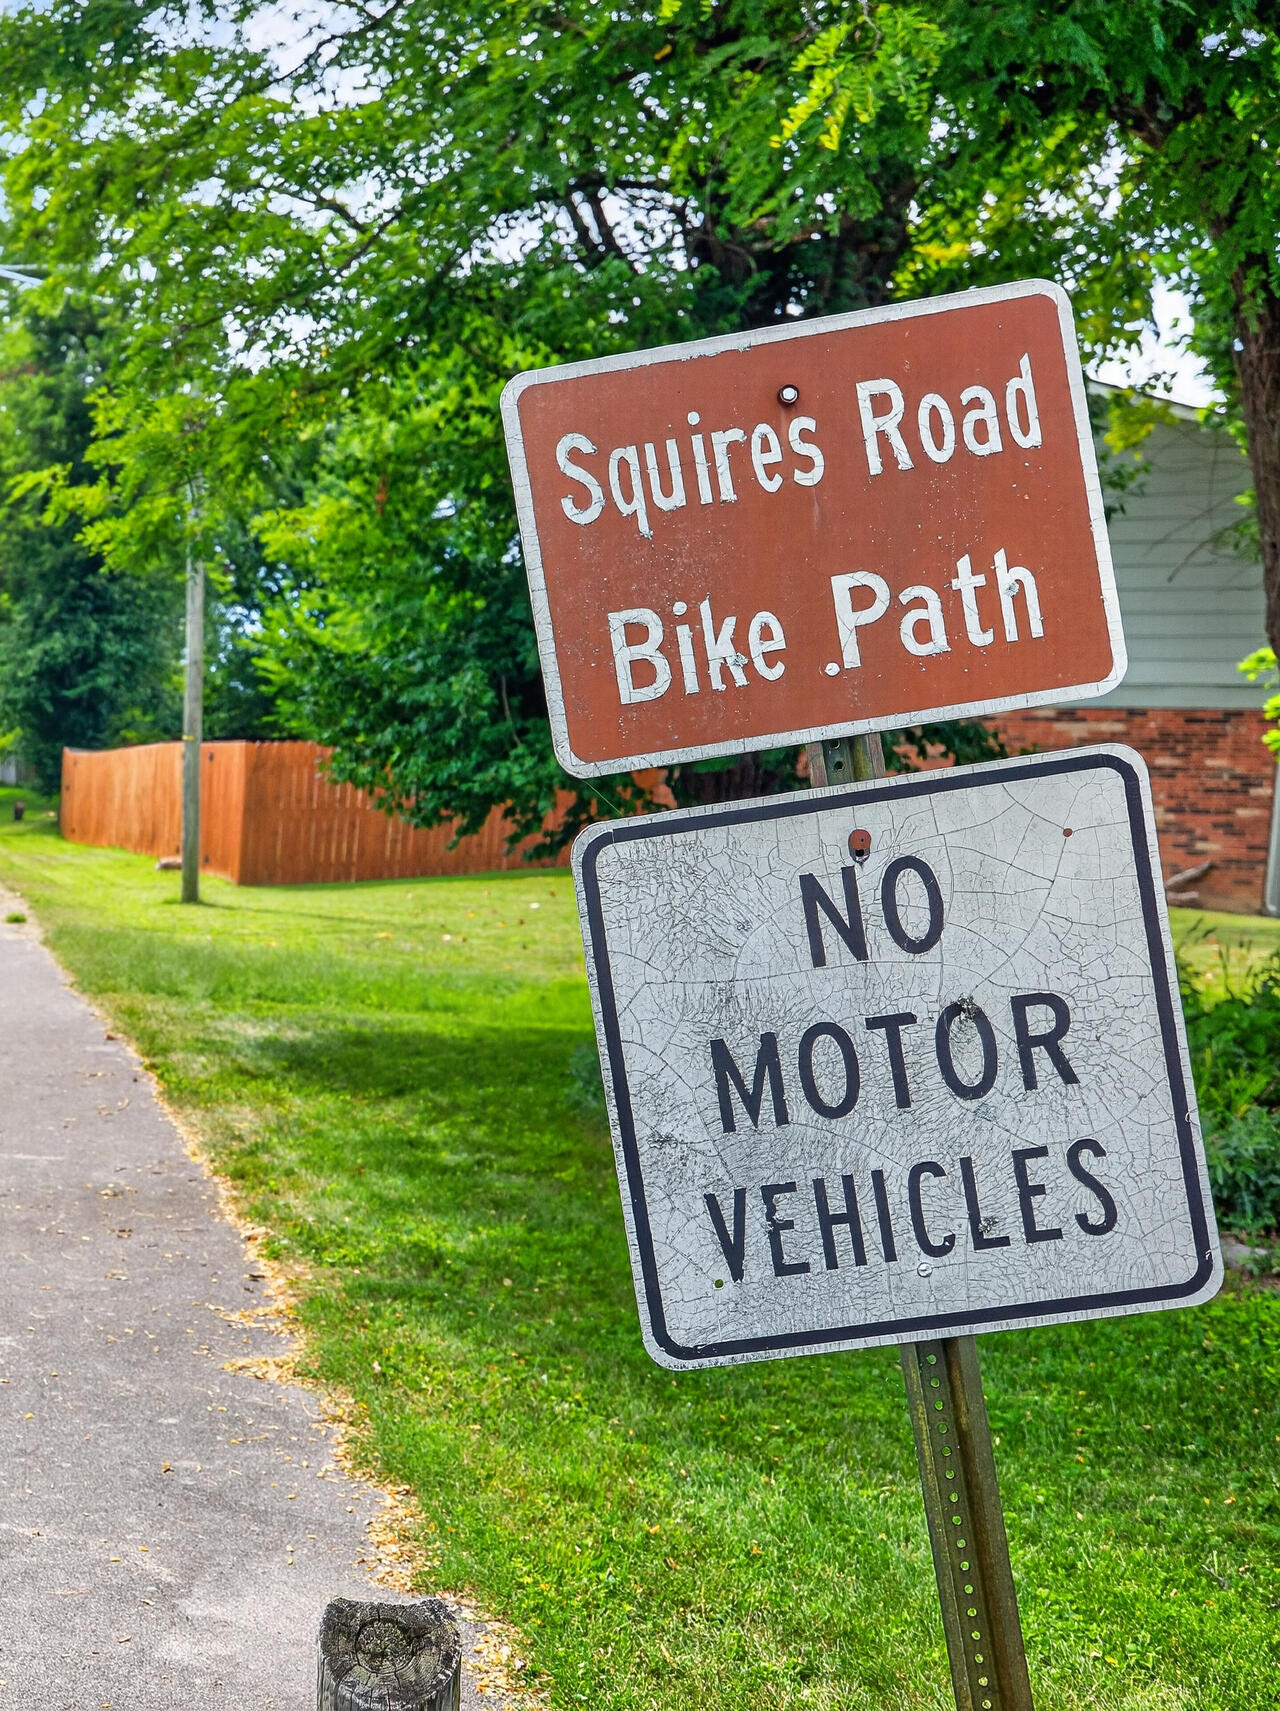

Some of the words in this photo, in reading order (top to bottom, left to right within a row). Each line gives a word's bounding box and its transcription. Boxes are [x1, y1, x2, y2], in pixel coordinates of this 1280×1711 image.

[555, 411, 826, 539] Squires
[855, 352, 1043, 477] Road
[607, 595, 787, 705] Bike
[830, 547, 1044, 669] Path
[799, 855, 946, 968] NO
[709, 992, 1080, 1133] MOTOR
[703, 1138, 1119, 1283] VEHICLES
